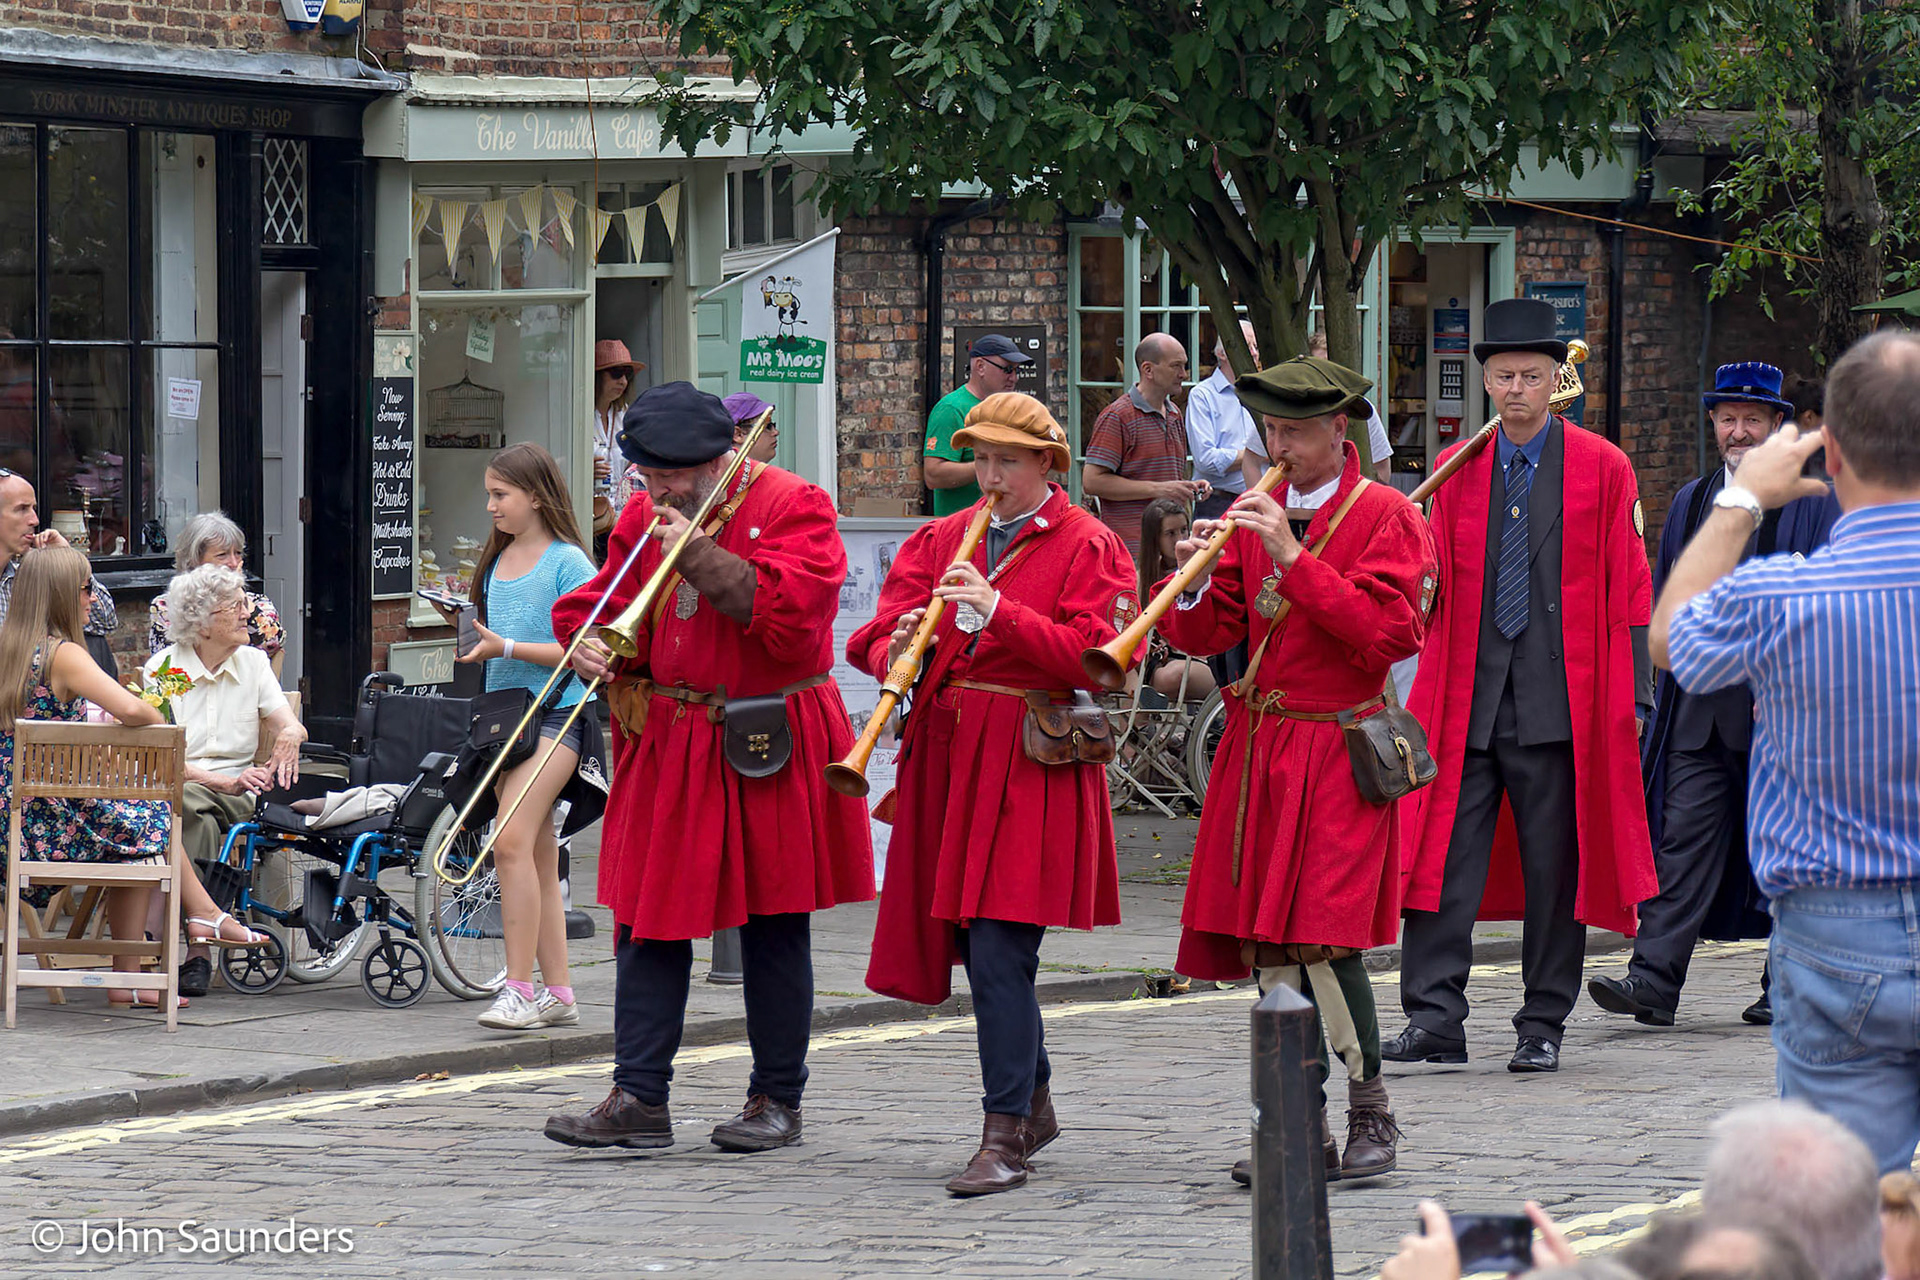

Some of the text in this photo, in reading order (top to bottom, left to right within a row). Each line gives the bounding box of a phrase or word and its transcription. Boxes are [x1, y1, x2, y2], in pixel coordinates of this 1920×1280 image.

[30, 89, 293, 128] YORK MINSTER ANTIQUES SHOP
[476, 112, 653, 157] The Vanilla Café
[746, 351, 772, 367] MR
[767, 369, 785, 379] dairy
[787, 370, 797, 378] ice
[382, 387, 404, 404] Now
[373, 435, 413, 458] Take Away
[373, 461, 387, 478] Hot
[395, 460, 413, 478] Cold
[374, 482, 410, 507] Drinks
[373, 520, 413, 539] Milkshakes
[373, 547, 411, 575] Cupcakes
[421, 647, 451, 680] The
